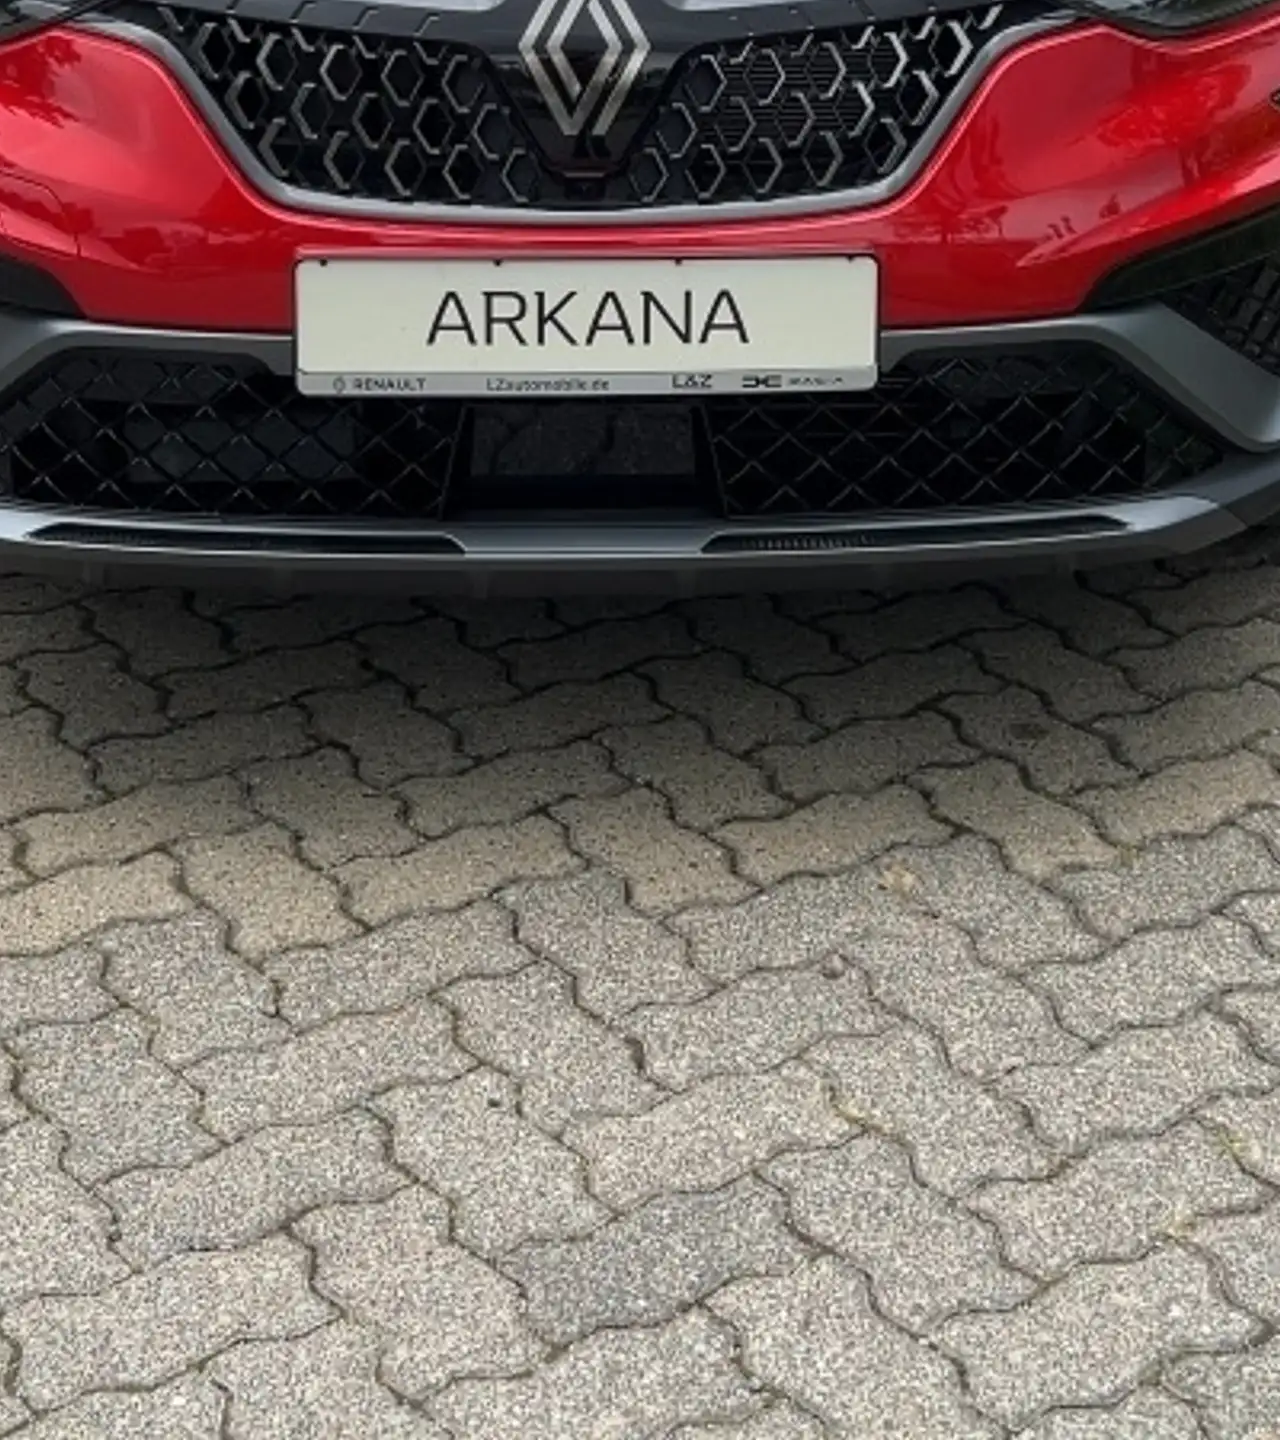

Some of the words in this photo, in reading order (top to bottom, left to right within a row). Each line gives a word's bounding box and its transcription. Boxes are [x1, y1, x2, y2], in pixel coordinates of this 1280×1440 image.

[426, 288, 750, 345] ARKANA
[351, 377, 427, 392] RENAULT
[485, 377, 610, 392] LZautomobile.de
[671, 373, 713, 389] L&Z
